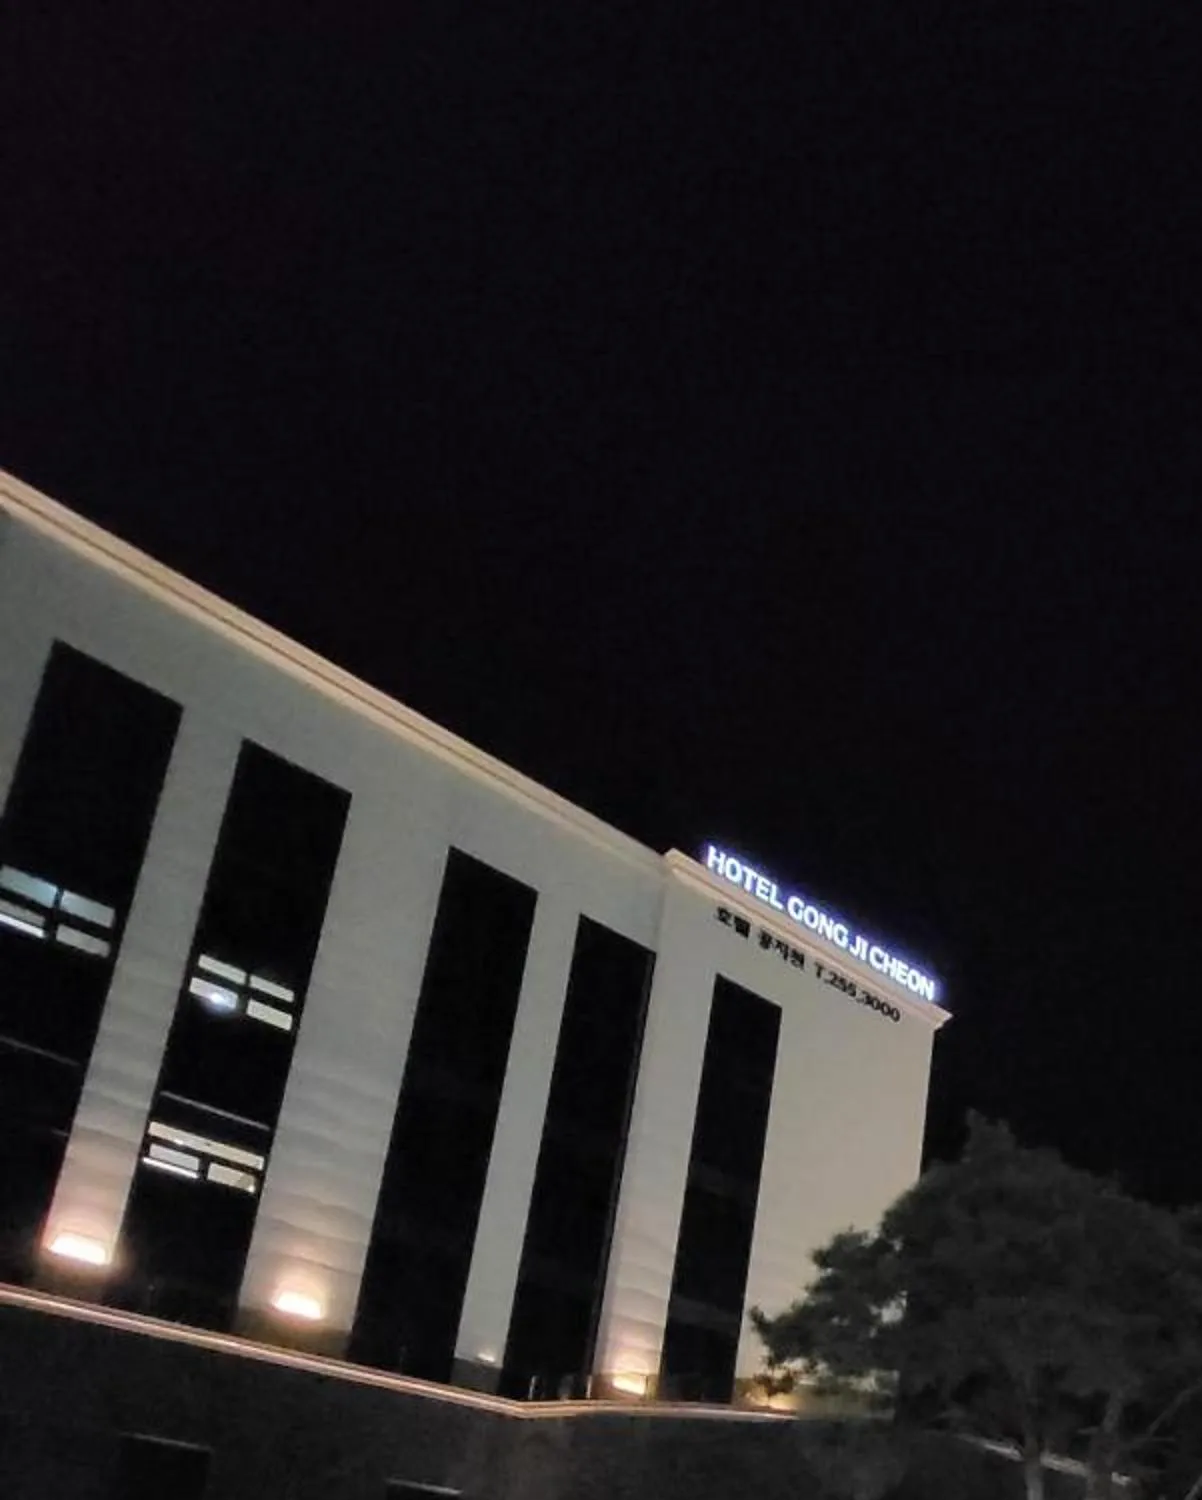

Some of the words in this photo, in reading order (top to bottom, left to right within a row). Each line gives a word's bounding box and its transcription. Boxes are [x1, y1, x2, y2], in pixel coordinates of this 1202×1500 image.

[707, 845, 784, 911] HOTEL
[785, 895, 849, 949] GONG
[849, 934, 868, 961] JI
[868, 945, 935, 1001] CHEON
